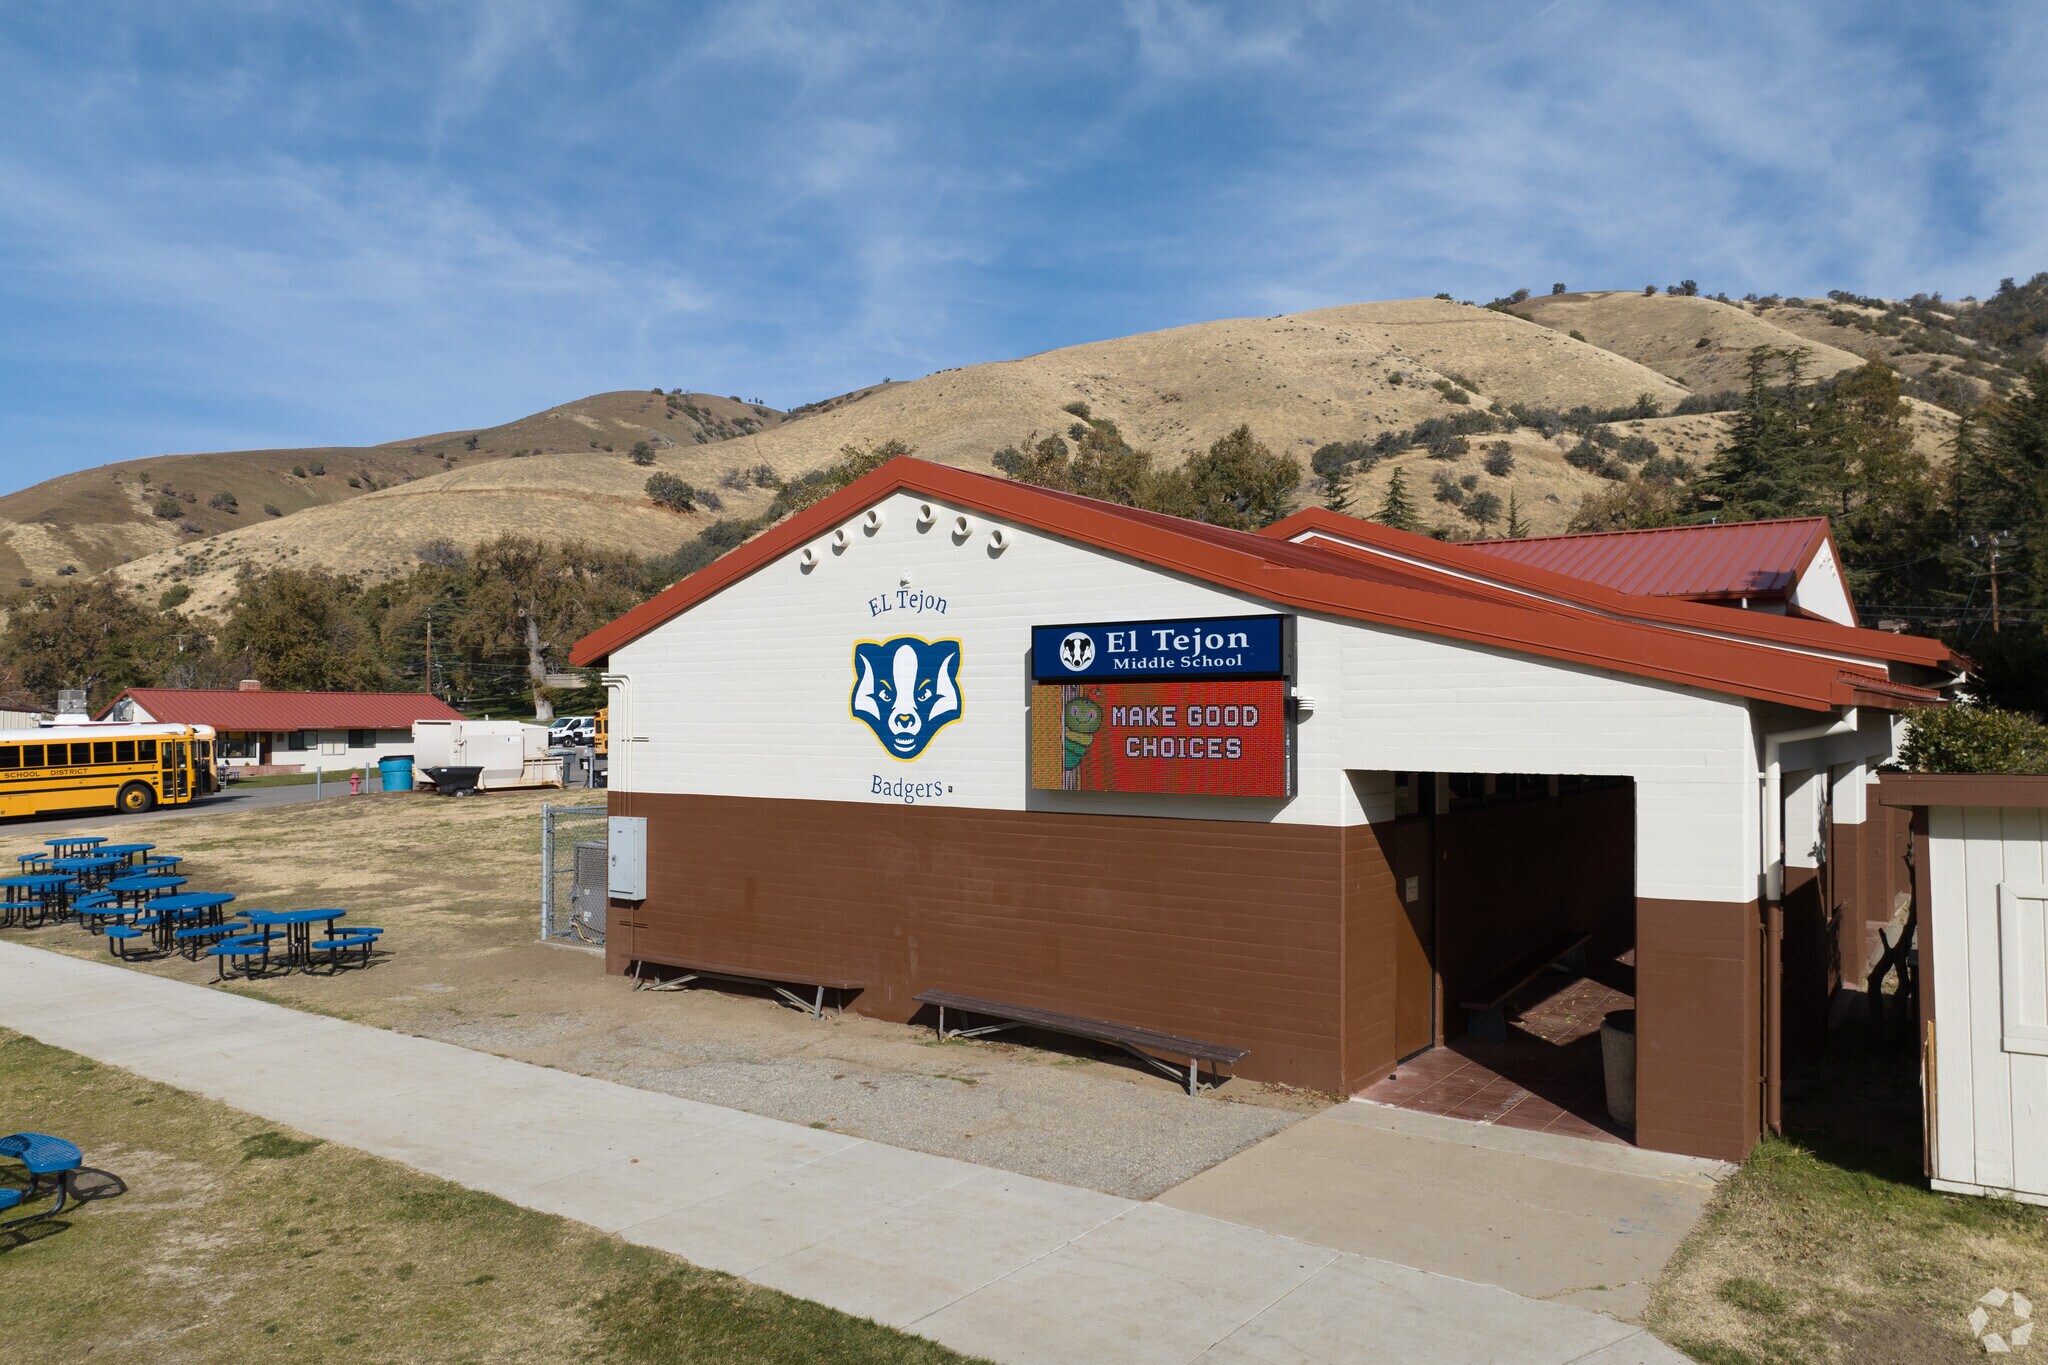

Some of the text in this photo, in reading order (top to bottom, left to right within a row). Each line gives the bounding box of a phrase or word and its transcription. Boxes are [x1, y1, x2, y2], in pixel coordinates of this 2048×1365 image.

[897, 589, 948, 615] Tejon
[1106, 627, 1250, 657] El Tejon
[1113, 654, 1243, 670] Middle School
[1111, 704, 1259, 727] MAKE GOOD
[1125, 736, 1242, 759] CHOICES
[4, 768, 88, 779] SCHOOL DISTRICT
[870, 774, 943, 804] Badgers
